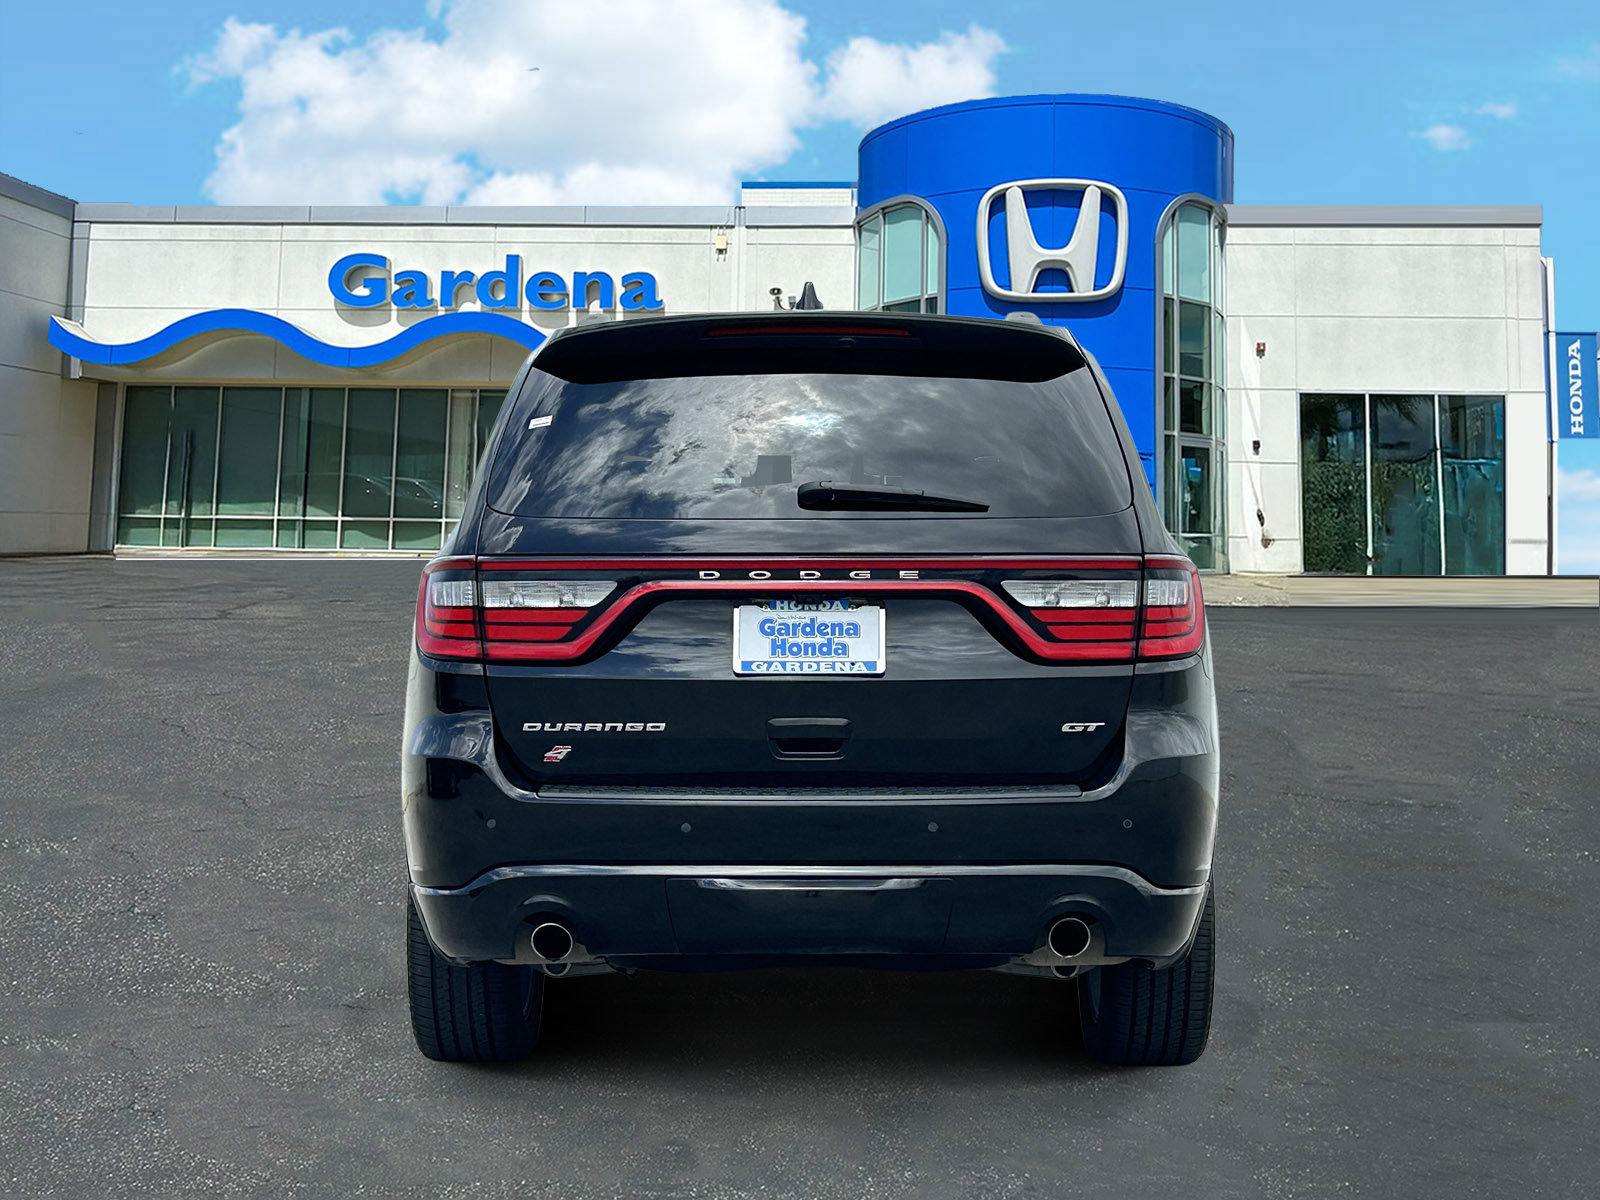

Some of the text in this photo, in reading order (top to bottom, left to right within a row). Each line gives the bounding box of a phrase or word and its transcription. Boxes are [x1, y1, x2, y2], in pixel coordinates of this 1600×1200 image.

[328, 253, 665, 311] Gardena
[1568, 339, 1584, 435] HONDA
[698, 570, 919, 580] DODGE
[776, 600, 844, 611] HONDA
[758, 616, 859, 637] Gardena
[770, 637, 849, 657] Honda
[750, 661, 868, 672] GARDENA
[522, 722, 666, 732] DURANGO
[1061, 722, 1105, 732] GT
